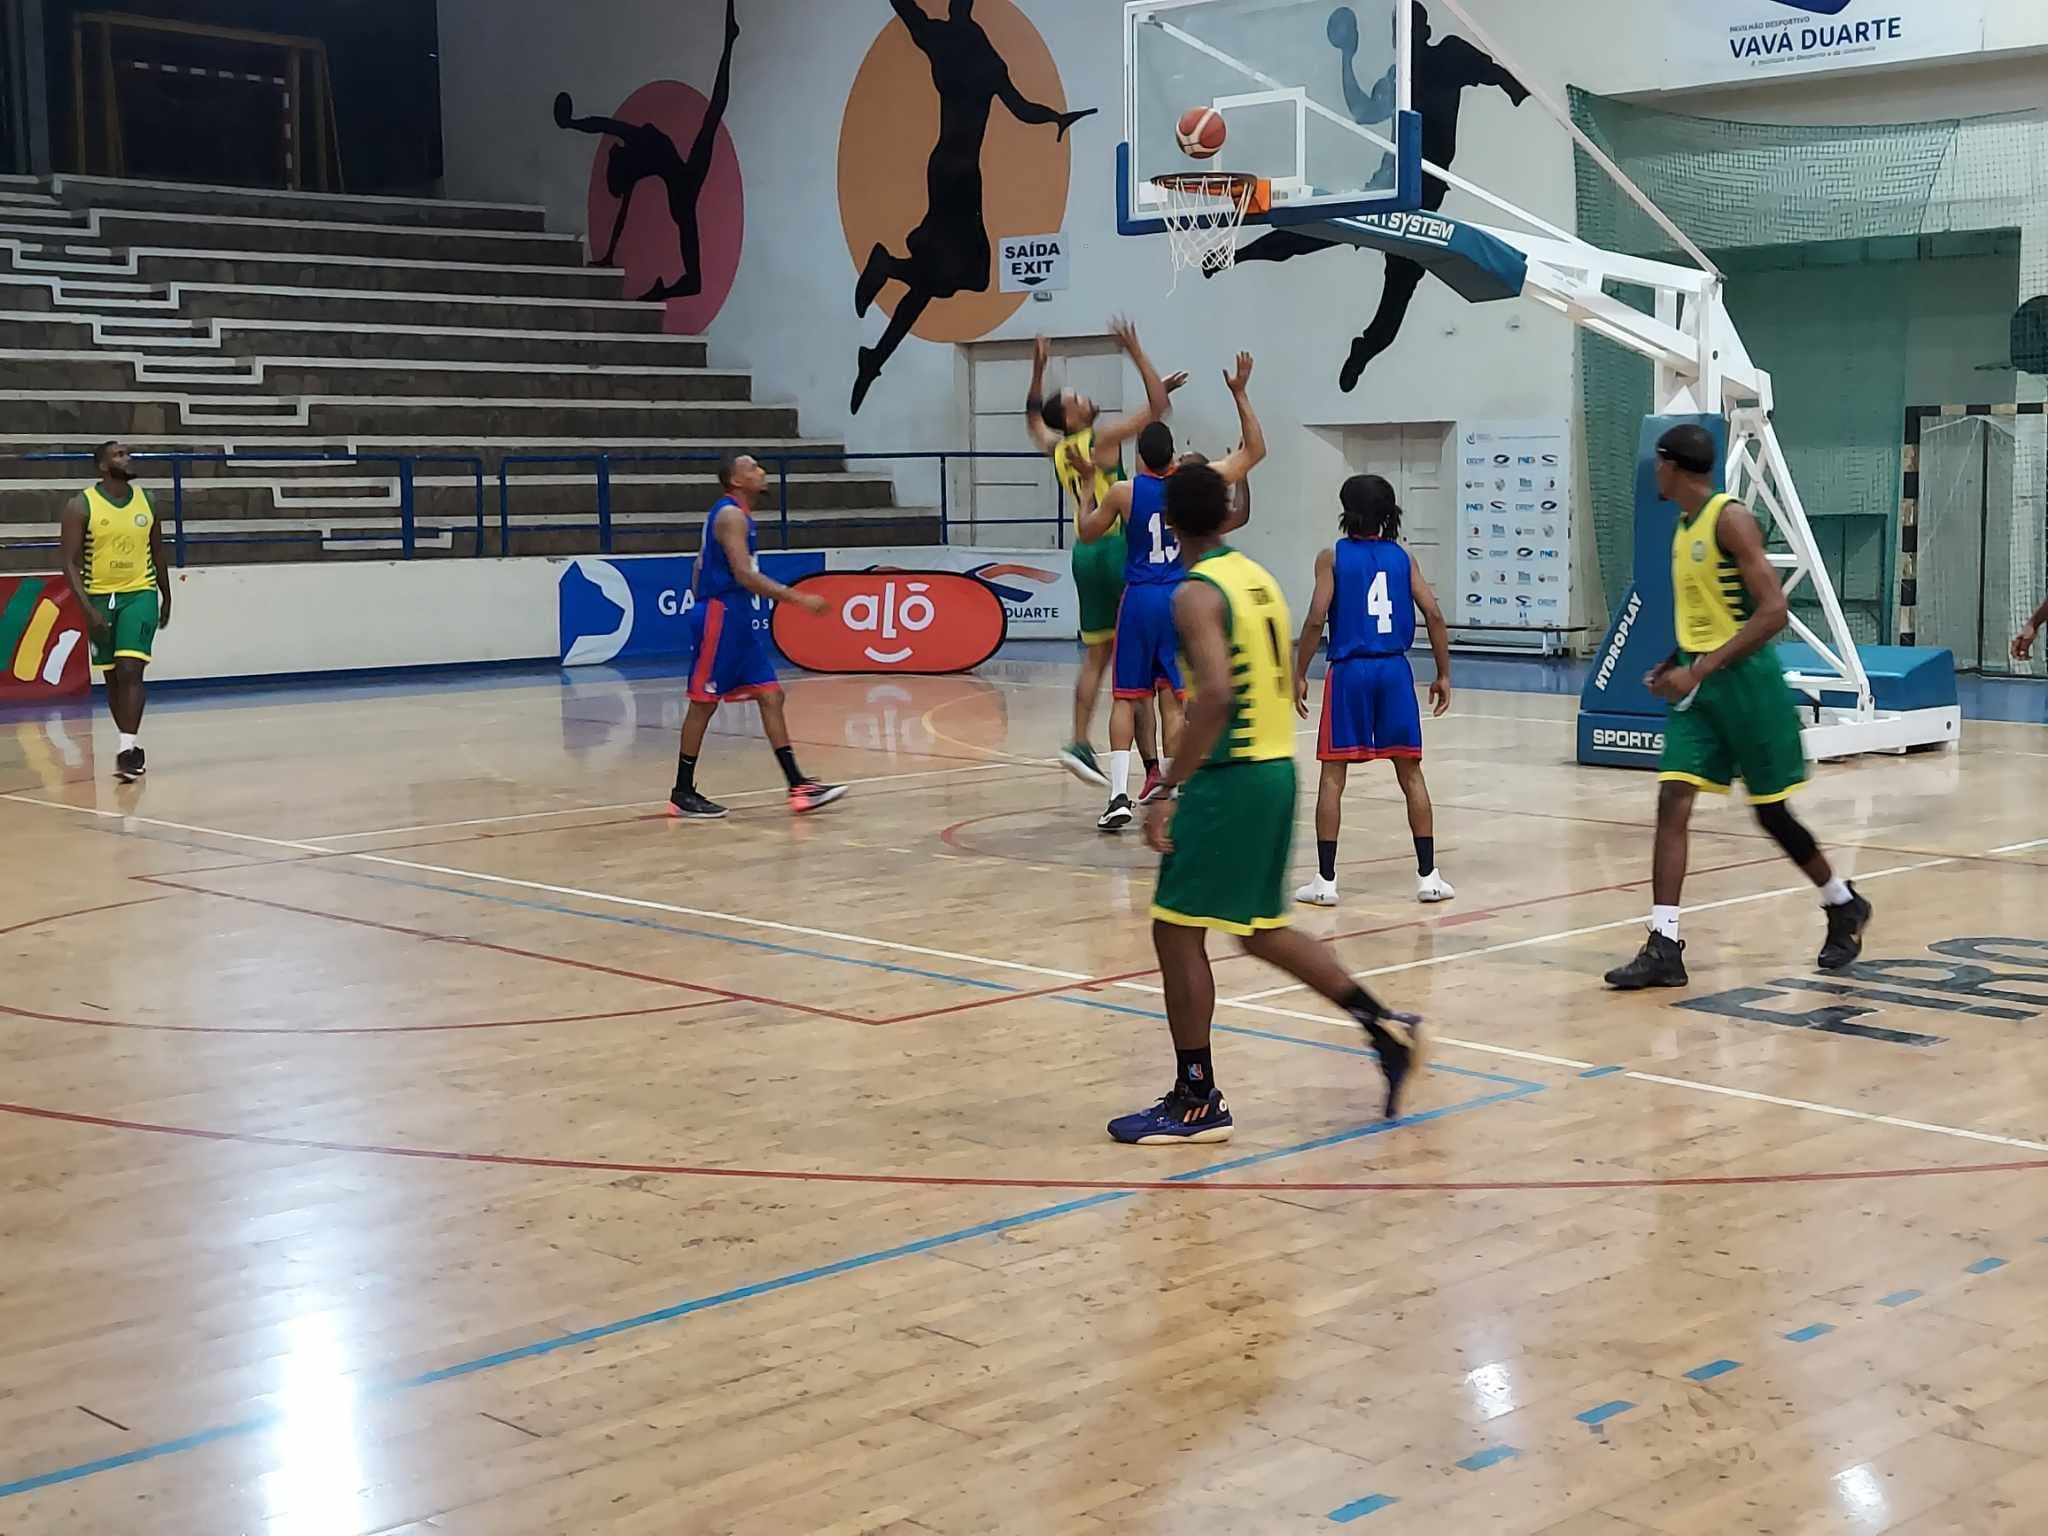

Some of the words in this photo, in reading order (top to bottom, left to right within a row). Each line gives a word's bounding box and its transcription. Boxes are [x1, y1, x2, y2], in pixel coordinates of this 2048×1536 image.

[1729, 26, 1793, 58] VAVÁ
[1801, 17, 1902, 50] DUARTE
[1005, 241, 1061, 259] SAÍDA
[1011, 260, 1054, 275] EXIT
[1005, 607, 1059, 618] DUARTE
[1367, 571, 1392, 633] 4
[1595, 591, 1643, 691] HYDROPLAY
